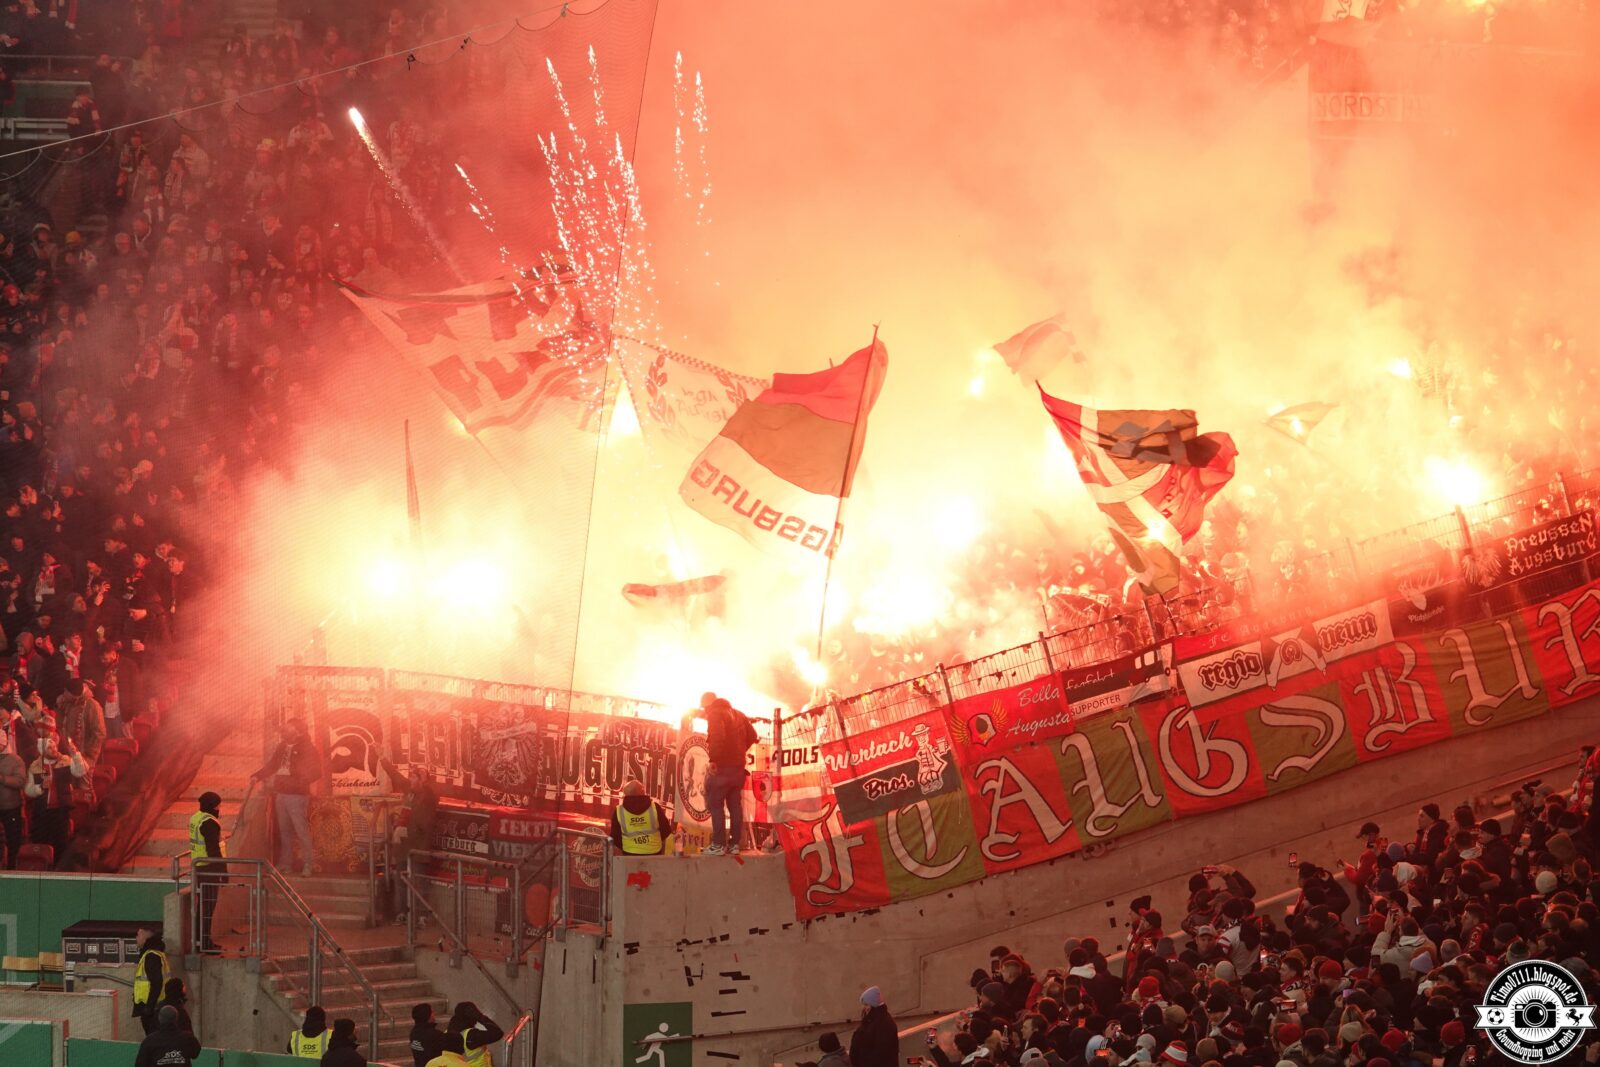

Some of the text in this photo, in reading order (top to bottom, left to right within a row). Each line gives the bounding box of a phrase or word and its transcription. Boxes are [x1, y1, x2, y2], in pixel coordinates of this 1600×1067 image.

[1318, 611, 1378, 651] neun
[1017, 683, 1061, 708] Bella
[1071, 693, 1121, 717] SUPPORTER
[1005, 711, 1071, 738] Augusta
[825, 731, 914, 771] Wertach
[862, 773, 915, 800] Bros.
